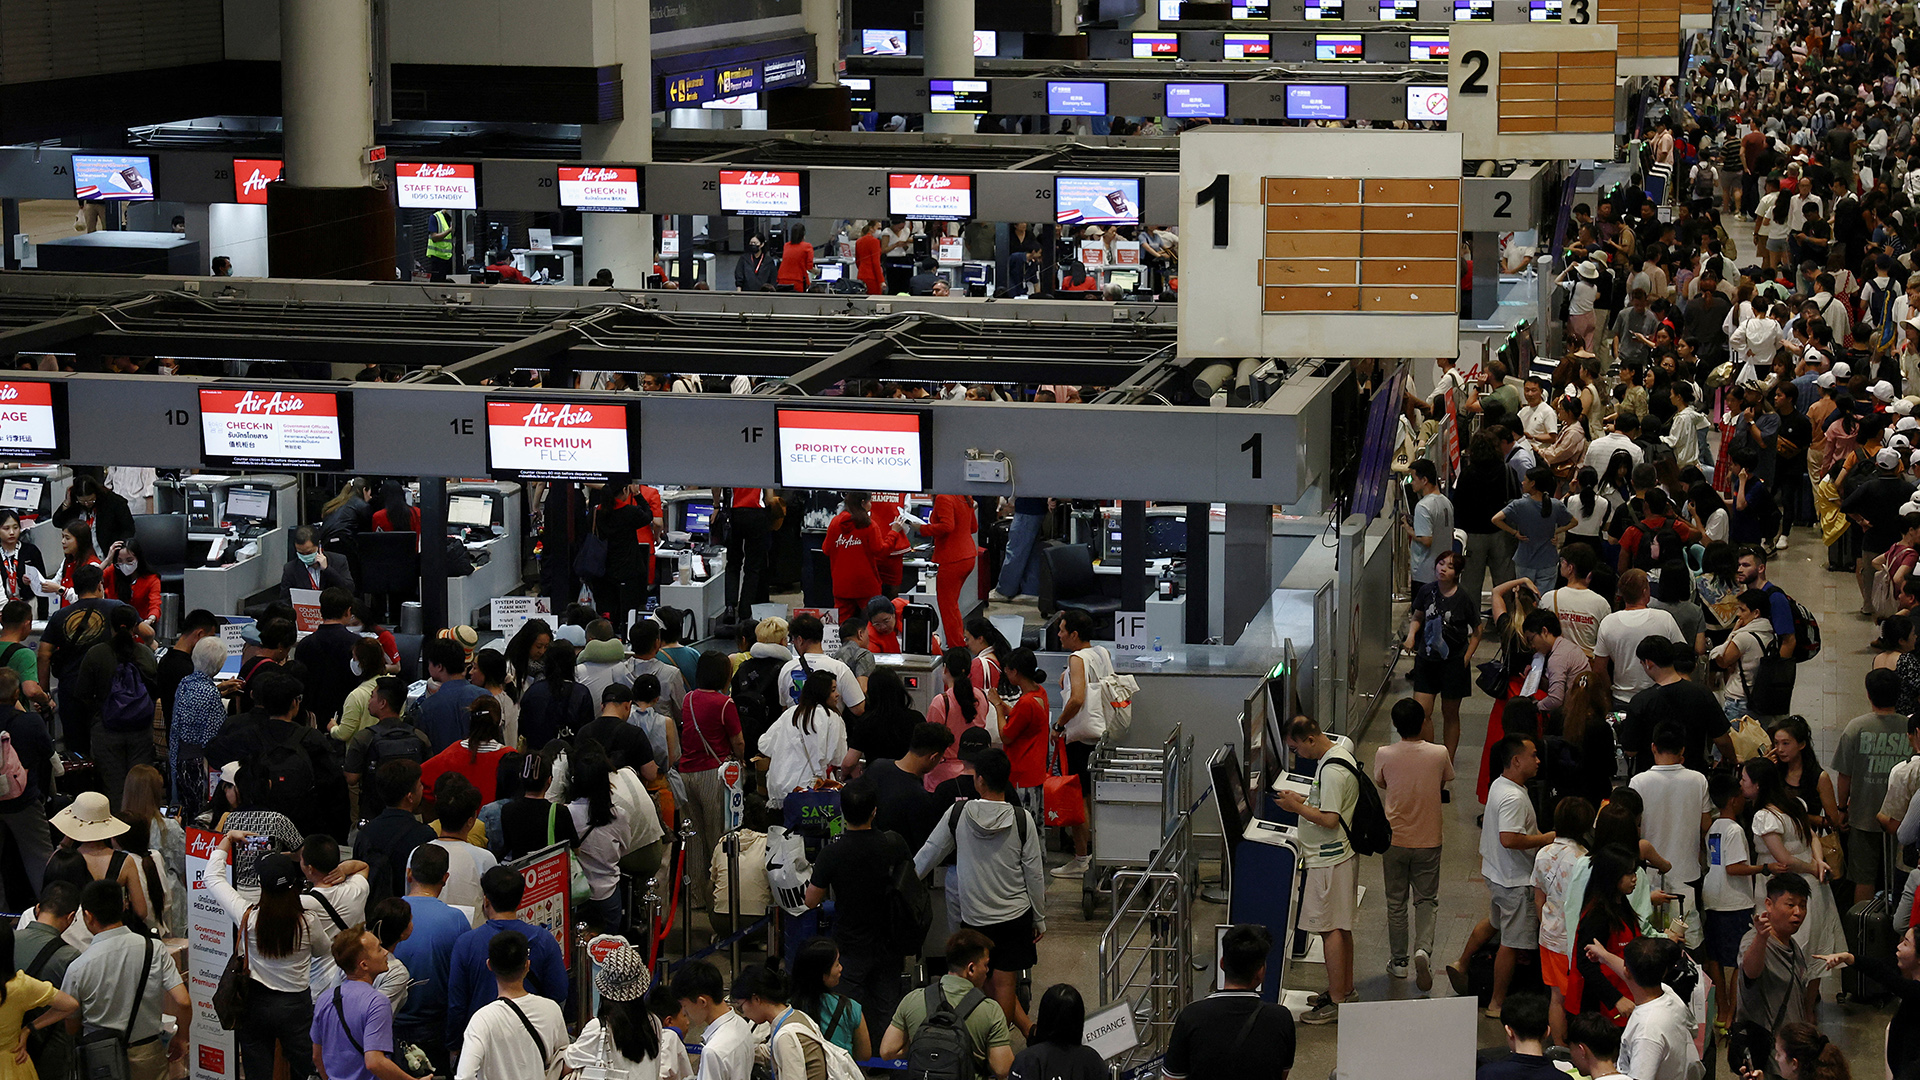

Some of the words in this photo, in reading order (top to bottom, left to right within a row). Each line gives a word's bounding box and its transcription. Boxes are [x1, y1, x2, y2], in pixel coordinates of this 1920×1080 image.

[1569, 0, 1590, 24] 3
[1118, 38, 1129, 46] 4D
[1210, 39, 1220, 47] 4E
[1459, 49, 1490, 94] 2
[915, 89, 926, 97] 3D
[1032, 91, 1043, 99] 3E
[1269, 94, 1281, 102] 3G
[1390, 96, 1402, 104] 3H
[53, 165, 68, 177] 2A
[214, 169, 229, 180] 2B
[404, 184, 431, 192] STAFF
[434, 185, 469, 193] TRAVEL
[537, 177, 552, 188] 2D
[702, 181, 716, 191] 2E
[584, 187, 628, 195] CHECK-IN
[745, 190, 789, 198] CHECK-IN
[868, 186, 882, 196] 2F
[1035, 189, 1051, 199] 2G
[915, 194, 960, 203] CHECK-IN
[1493, 191, 1512, 218] 2
[1196, 174, 1230, 247] 1
[164, 409, 190, 426] 1D
[226, 421, 273, 431] CHECK-IN
[450, 418, 474, 435] 1E
[741, 426, 764, 443] 1F
[524, 436, 592, 449] PREMIUM
[795, 443, 847, 453] PRIORITY
[851, 446, 905, 455] COUNTER
[540, 449, 578, 462] FLEX
[790, 453, 817, 463] SELF
[820, 455, 874, 465] CHECK-IN
[877, 456, 911, 466] KIOSK
[1240, 432, 1263, 479] 1
[1116, 616, 1146, 637] 1F
[1130, 643, 1146, 651] Drop
[801, 804, 834, 818] SAVE
[538, 858, 560, 872] DANGEROUS
[538, 868, 551, 878] GOODS
[538, 877, 545, 885] ON
[545, 870, 562, 882] AIRCRAFT
[193, 902, 205, 910] RED
[194, 923, 226, 938] Government
[199, 933, 221, 945] Officials
[192, 976, 216, 989] Premium
[201, 1010, 217, 1020] BLACK
[1085, 1016, 1127, 1042] ENTRANCE
